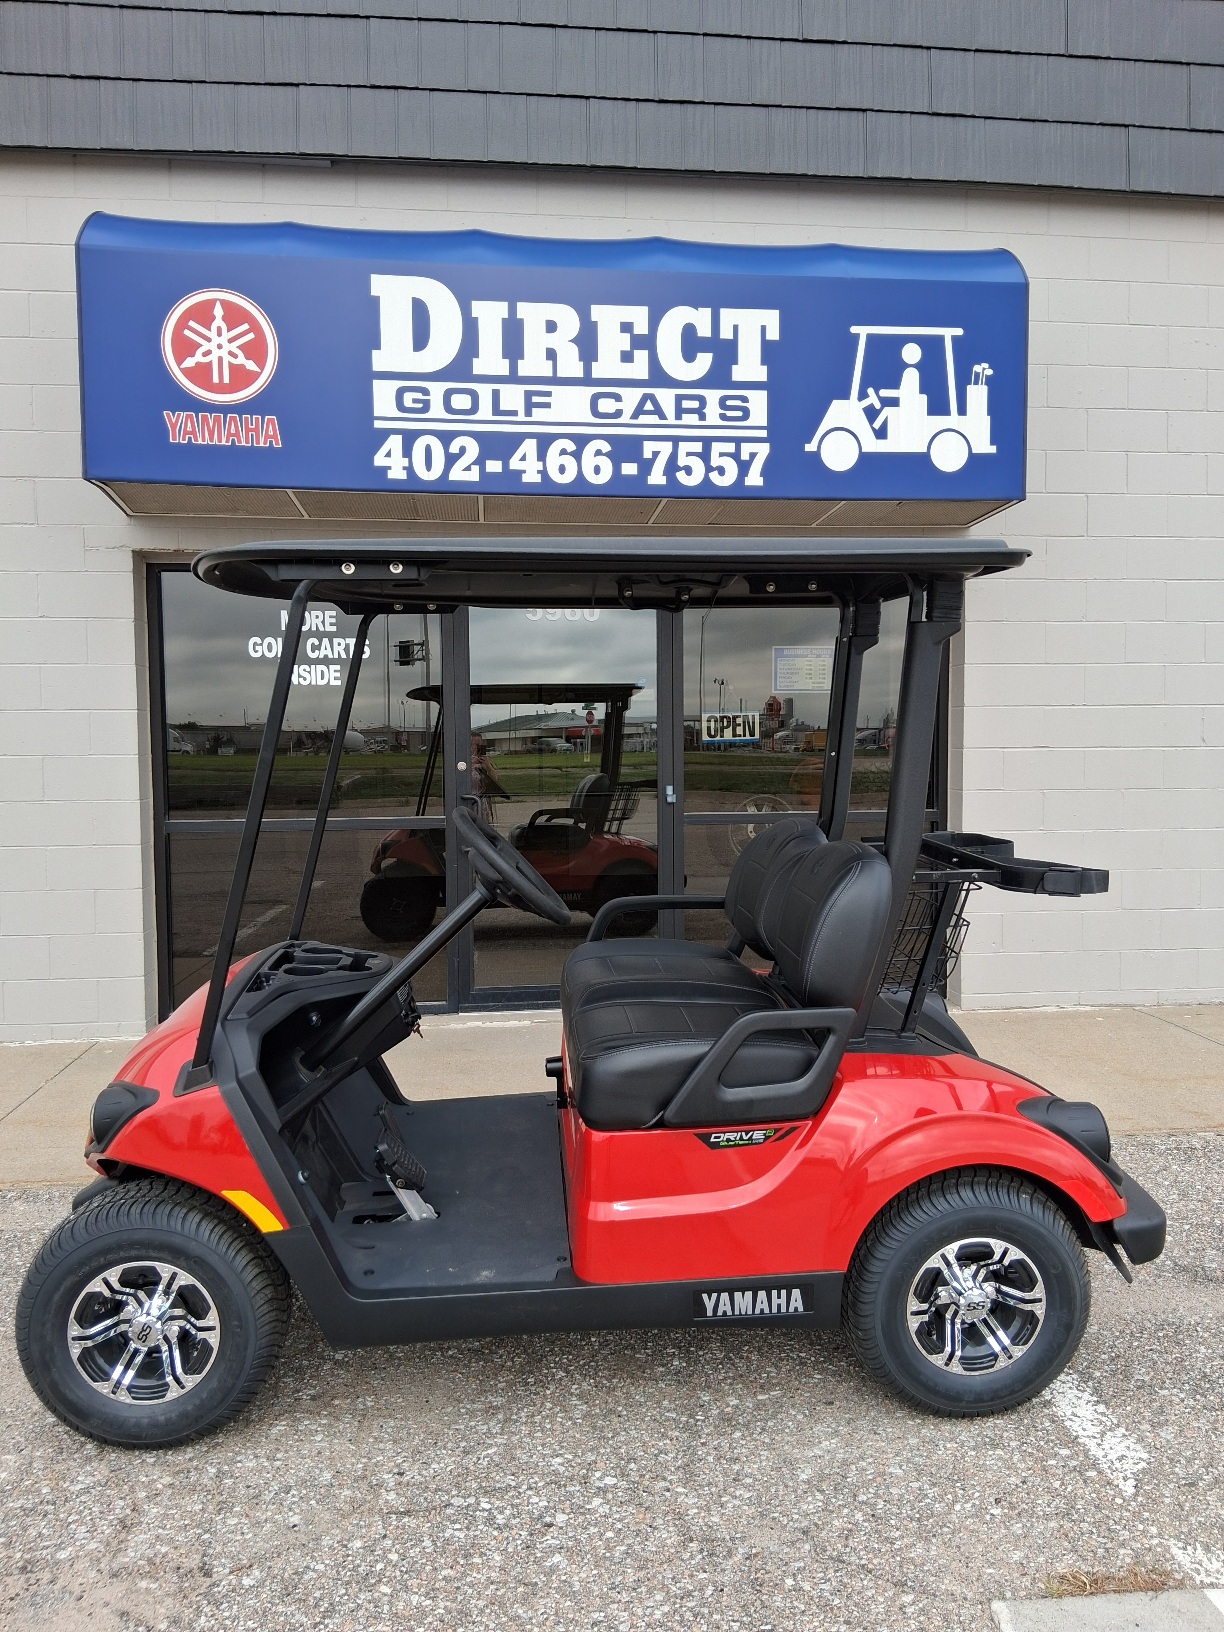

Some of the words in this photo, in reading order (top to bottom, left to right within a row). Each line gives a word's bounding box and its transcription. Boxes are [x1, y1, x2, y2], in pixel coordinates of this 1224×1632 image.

[370, 273, 780, 382] DIRECT
[395, 385, 552, 418] GOLF
[589, 391, 751, 422] CARS
[163, 411, 282, 447] YAMAHA
[373, 434, 770, 487] 402-466-7557
[706, 714, 756, 739] OPEN
[701, 1288, 804, 1317] YAMAHA
